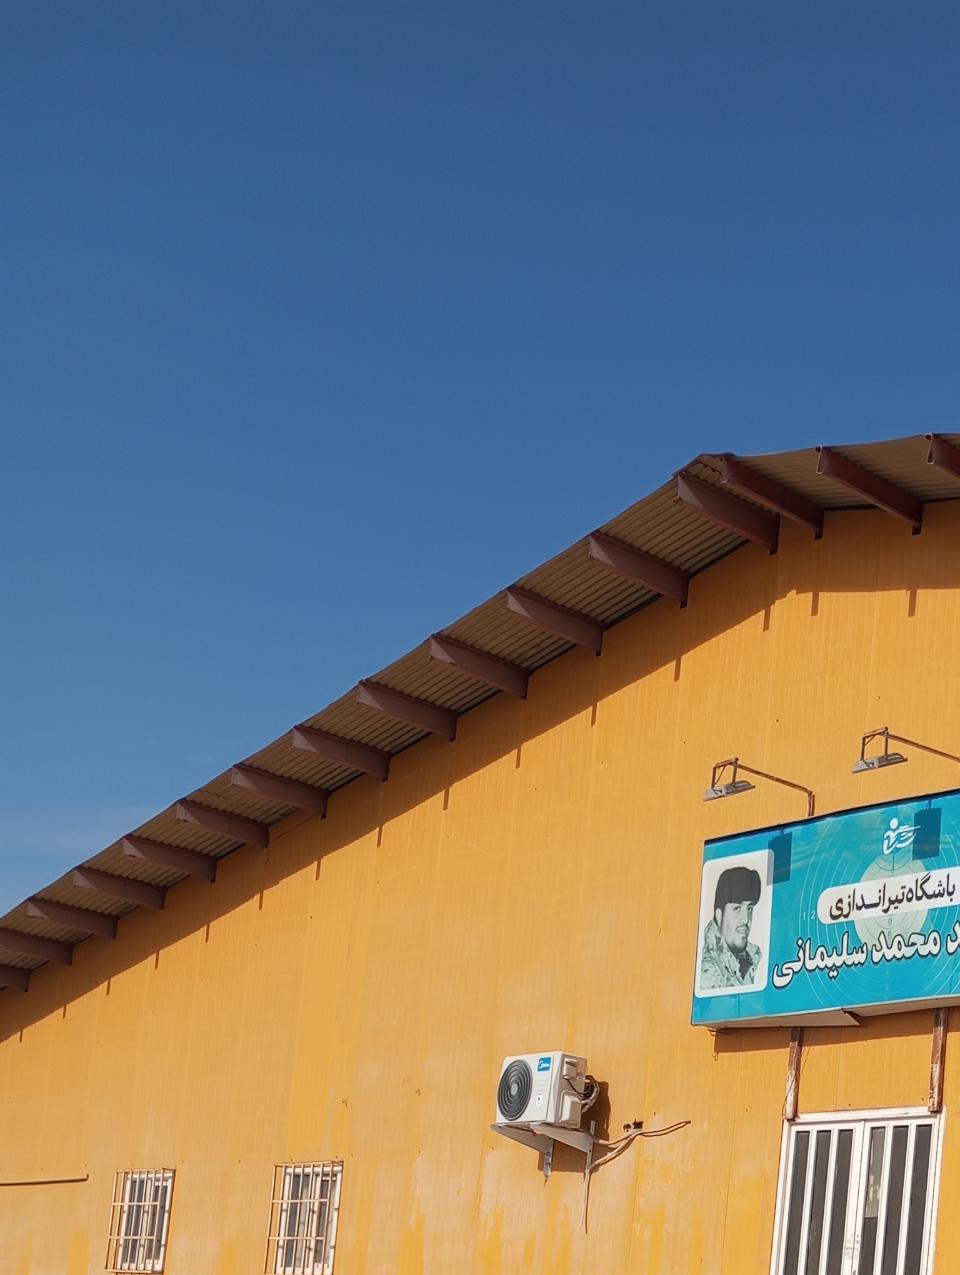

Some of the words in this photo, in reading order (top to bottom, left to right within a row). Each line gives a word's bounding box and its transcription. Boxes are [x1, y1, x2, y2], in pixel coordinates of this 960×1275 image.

[829, 882, 906, 921] تیراندازی
[906, 872, 956, 902] باشگاه
[771, 930, 868, 989] سلیمانی
[871, 929, 941, 963] محمد
